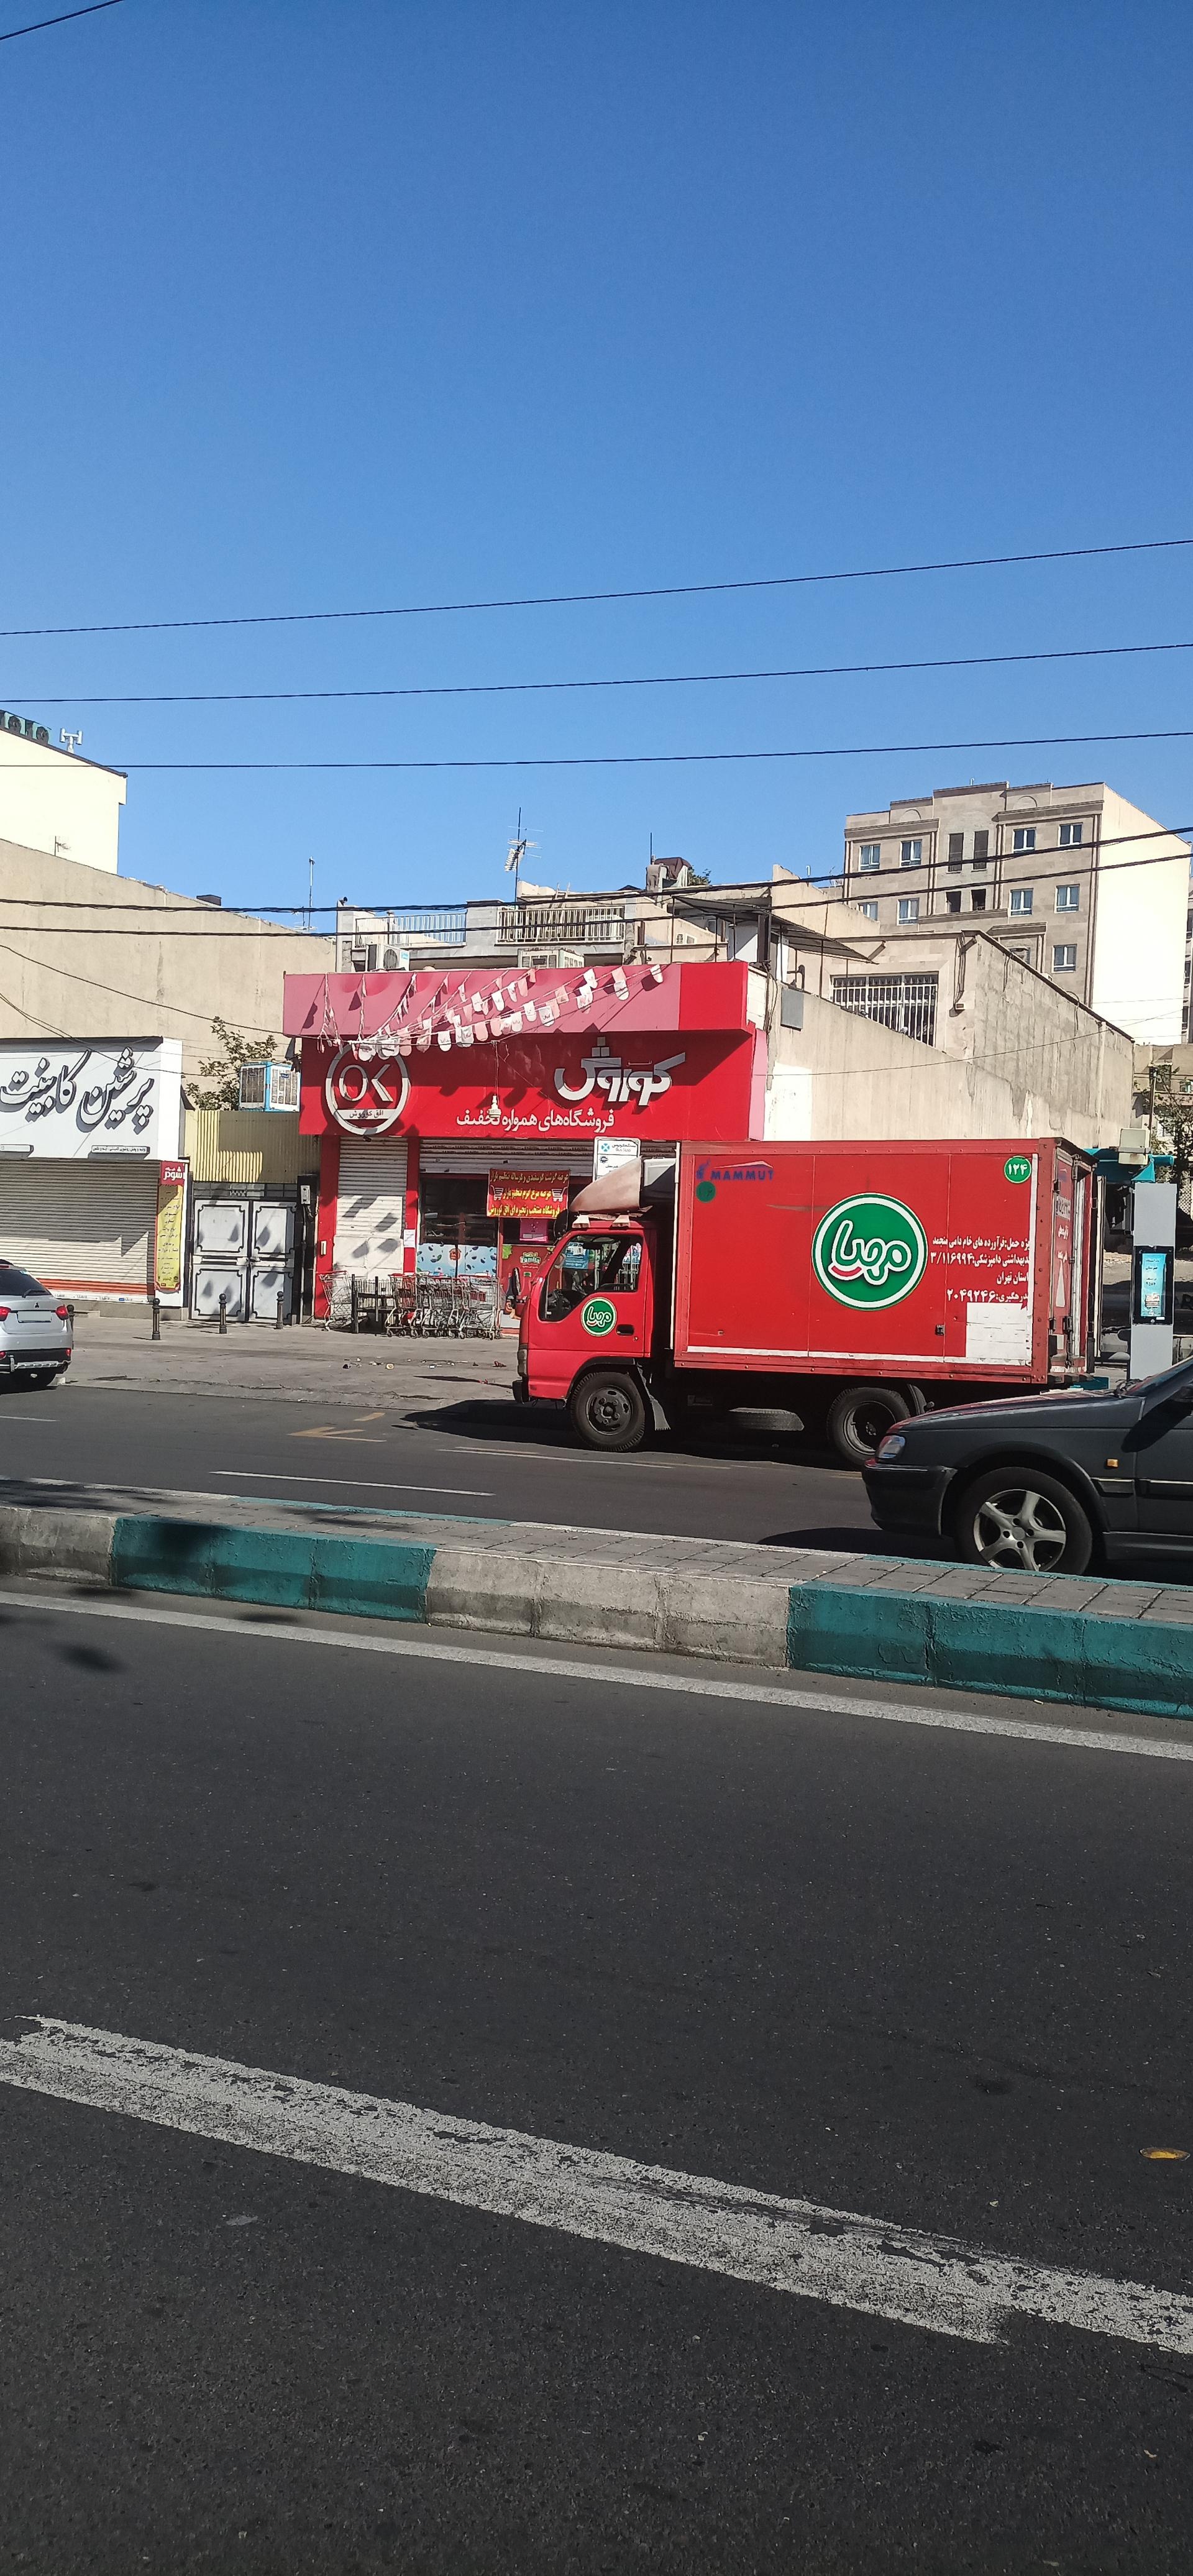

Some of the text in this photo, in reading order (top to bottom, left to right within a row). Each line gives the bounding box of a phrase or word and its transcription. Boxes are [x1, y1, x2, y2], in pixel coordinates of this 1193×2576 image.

[554, 1037, 686, 1106] کوروش
[0, 1047, 153, 1129] پرشین کابینت
[339, 1064, 394, 1101] OK
[349, 1109, 384, 1119] افق کوروش
[457, 1109, 501, 1126] تخفیف
[501, 1108, 537, 1132] همواره
[711, 1170, 774, 1180] MAMMUT
[1008, 1163, 1028, 1175] ۱۲۴
[545, 1173, 557, 1183] گوشت
[531, 1189, 540, 1200] مرغ
[488, 1204, 503, 1216] کوروش
[542, 1204, 560, 1217] فروشگاه
[933, 1236, 948, 1248] منجمد
[949, 1235, 962, 1249] دامی
[962, 1235, 972, 1249] خام
[1021, 1237, 1030, 1251] یژه
[996, 1271, 1012, 1285] تهران
